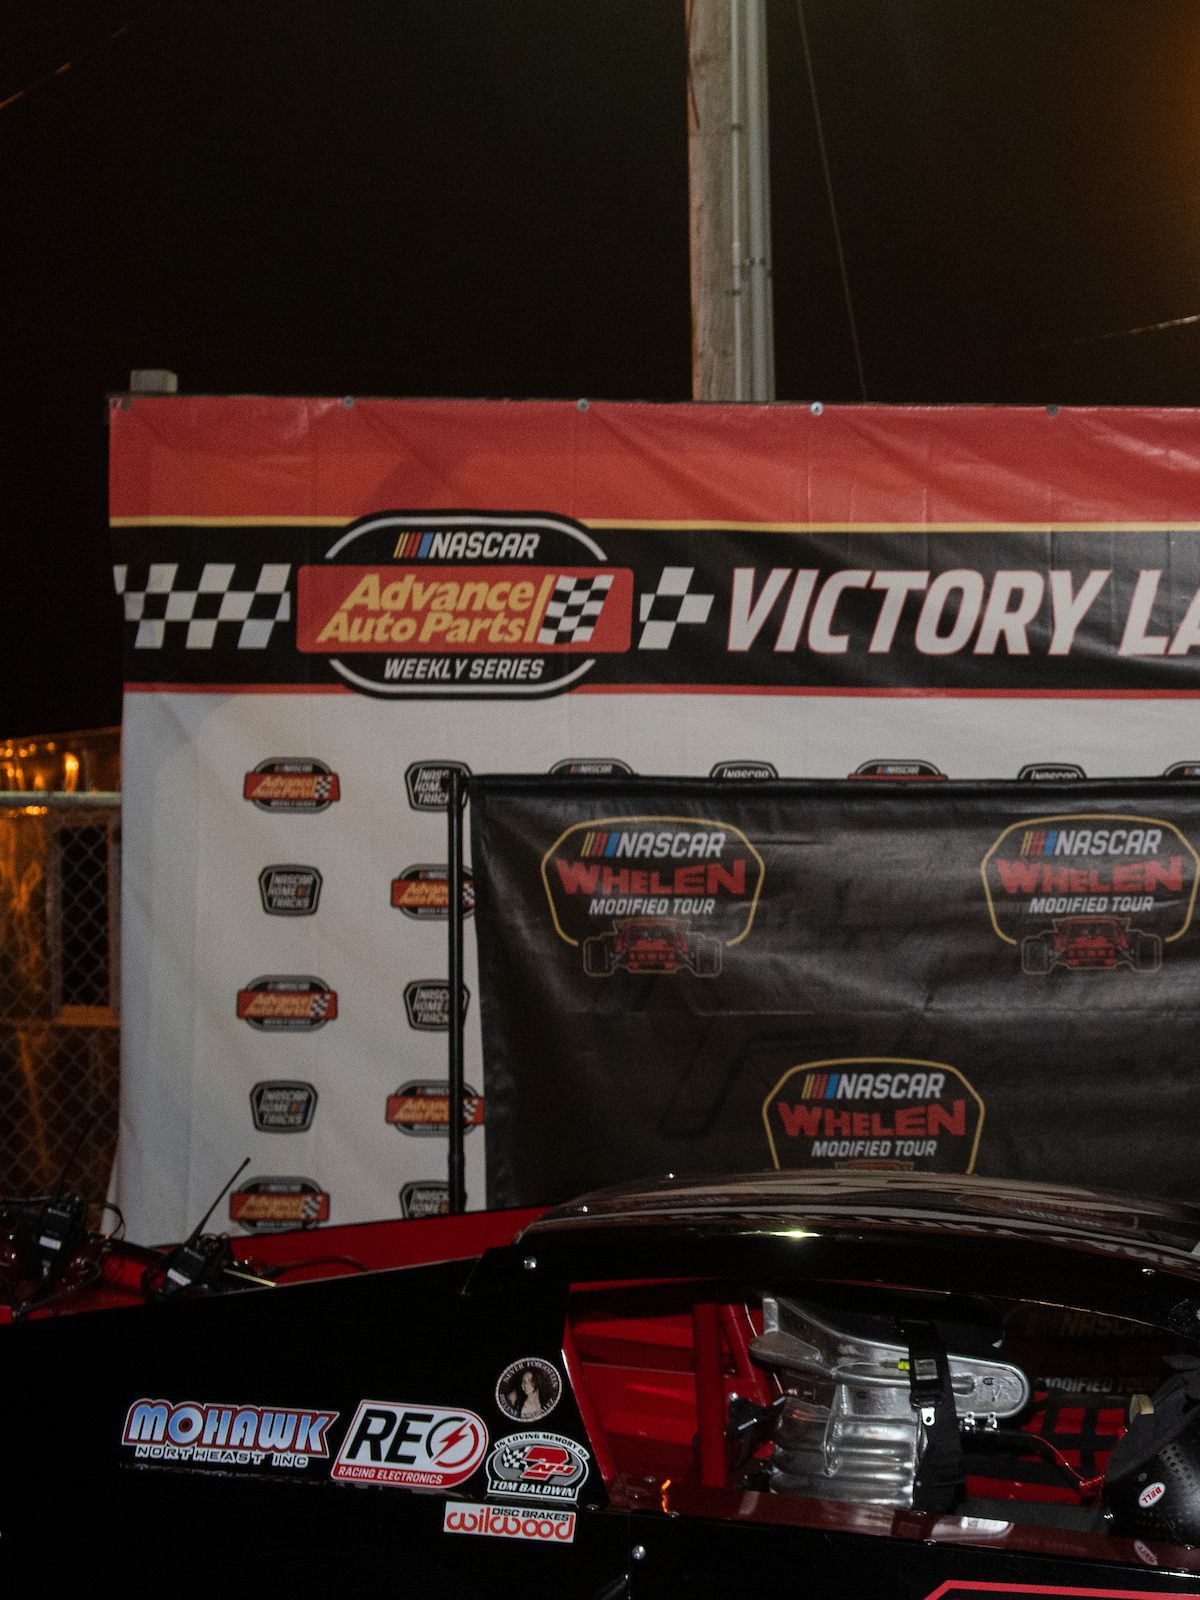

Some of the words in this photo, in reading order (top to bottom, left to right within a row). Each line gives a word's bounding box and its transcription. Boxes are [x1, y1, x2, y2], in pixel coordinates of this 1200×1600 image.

[429, 532, 540, 559] NASCAR
[340, 573, 535, 613] Advance
[727, 566, 1111, 656] VICTORY
[315, 611, 417, 644] Auto
[418, 611, 527, 644] Parts
[384, 658, 464, 680] WEEKLY
[469, 658, 545, 680] SERIES
[616, 832, 727, 857] NASCAR
[1055, 829, 1163, 856] NASCAR
[555, 859, 746, 895] WHELEN
[997, 856, 1183, 894] WHELEN
[589, 898, 667, 915] MODIFIED
[672, 898, 716, 915] TOUR
[1029, 897, 1108, 914] MODIFIED
[1111, 896, 1154, 912] TOUR
[837, 1073, 945, 1099] NASCAR
[777, 1099, 966, 1136] WHELEN
[811, 1141, 894, 1158] MODIFIED
[895, 1140, 938, 1157] TOUR
[124, 1400, 336, 1456] MOHAWK
[135, 1445, 265, 1466] NORTHEAST
[272, 1452, 309, 1468] INC
[496, 1440, 506, 1449] IN
[507, 1433, 540, 1444] LOVING
[542, 1434, 577, 1450] MEMORY
[578, 1449, 588, 1459] OF
[338, 1466, 376, 1479] RACING
[377, 1467, 444, 1485] ELECTRONICS
[492, 1481, 518, 1492] TOM
[519, 1482, 575, 1497] BALDWIN
[446, 1506, 575, 1540] wilwood
[492, 1507, 520, 1517] DISC
[522, 1511, 570, 1521] BRAKES
